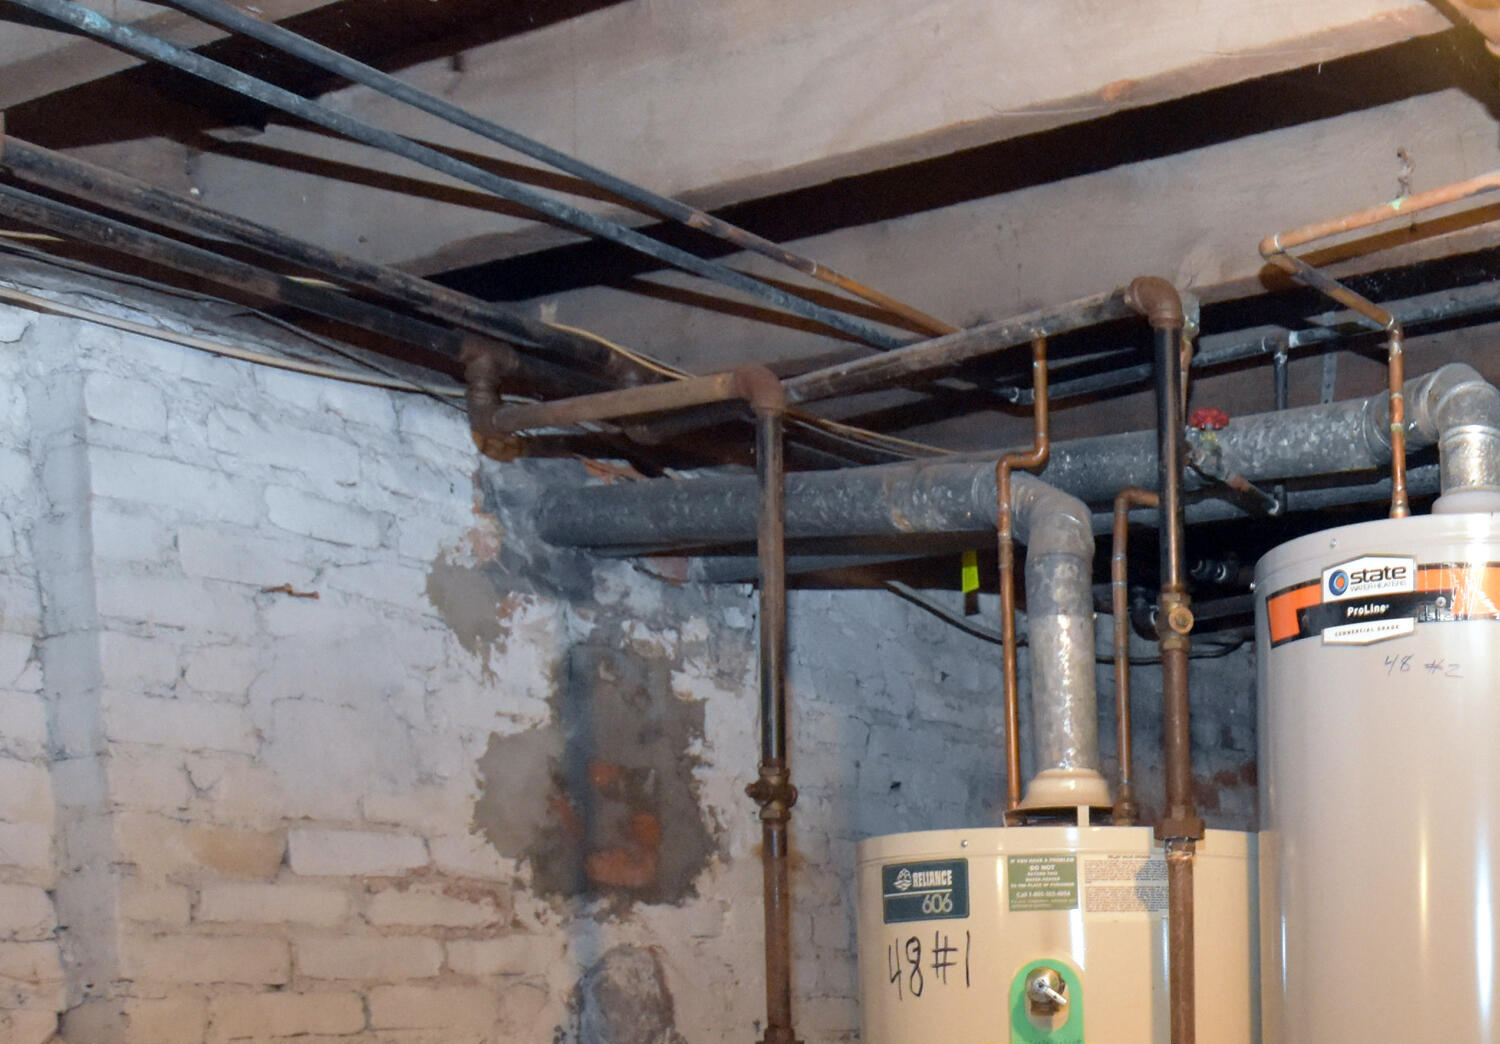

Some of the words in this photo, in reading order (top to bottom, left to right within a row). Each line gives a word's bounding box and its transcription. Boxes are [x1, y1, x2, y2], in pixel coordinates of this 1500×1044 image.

[1350, 566, 1406, 585] state
[1384, 654, 1415, 677] 48
[912, 869, 953, 888] RELIANCE
[922, 893, 953, 914] 606
